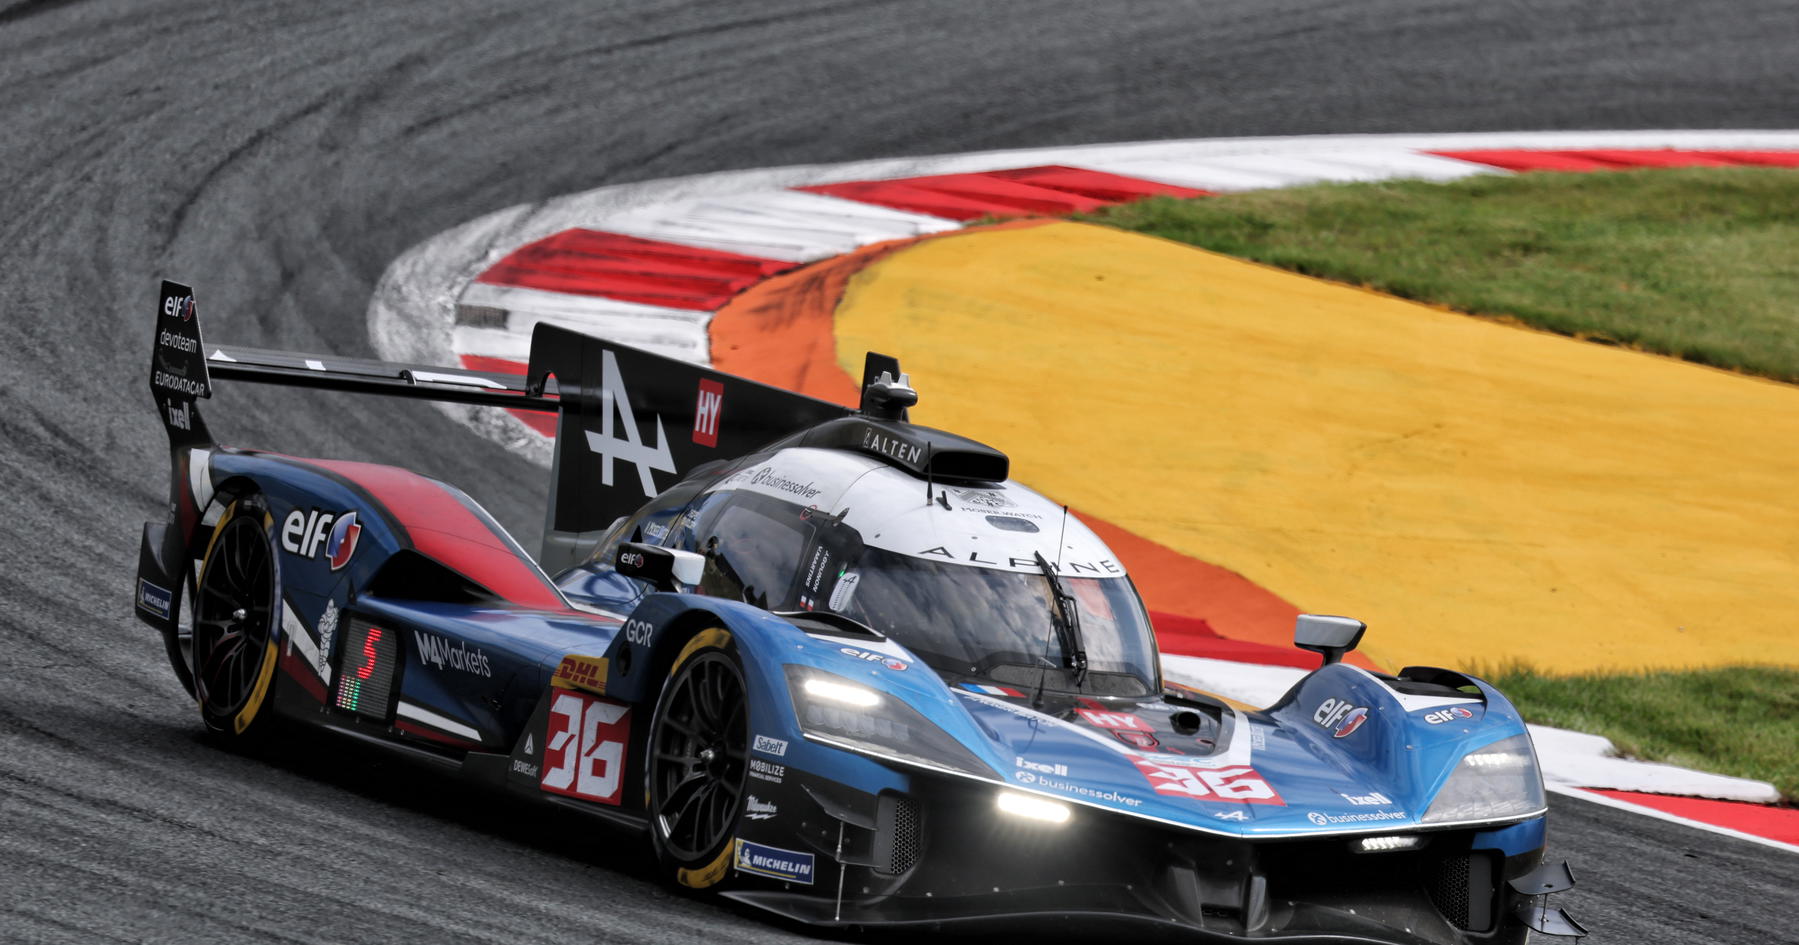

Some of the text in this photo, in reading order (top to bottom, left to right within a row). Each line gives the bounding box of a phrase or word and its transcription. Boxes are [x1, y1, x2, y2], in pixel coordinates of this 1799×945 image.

[165, 296, 184, 318] elf
[160, 328, 197, 353] devoteam
[155, 371, 205, 397] EURODATACAR
[168, 398, 191, 431] ixell
[694, 387, 722, 437] HY
[870, 433, 922, 464] ALTEN
[761, 470, 822, 499] businessolver
[281, 509, 335, 559] elf
[620, 552, 636, 565] elf
[918, 545, 1120, 574] ALPINE
[626, 618, 653, 648] GCR
[414, 629, 492, 678] M4Markets
[840, 646, 884, 662] elf
[559, 657, 600, 687] DHL
[1085, 711, 1138, 729] HY
[1313, 698, 1352, 728] elf
[1424, 707, 1453, 725] elf
[541, 694, 631, 798] 36
[755, 736, 784, 754] Sabelt
[1016, 756, 1068, 778] ixell
[1135, 759, 1276, 800] 36
[1039, 776, 1143, 808] businessolver
[1340, 792, 1392, 806] ixell
[1328, 810, 1406, 824] businessolver
[752, 854, 811, 875] MICHELIN
